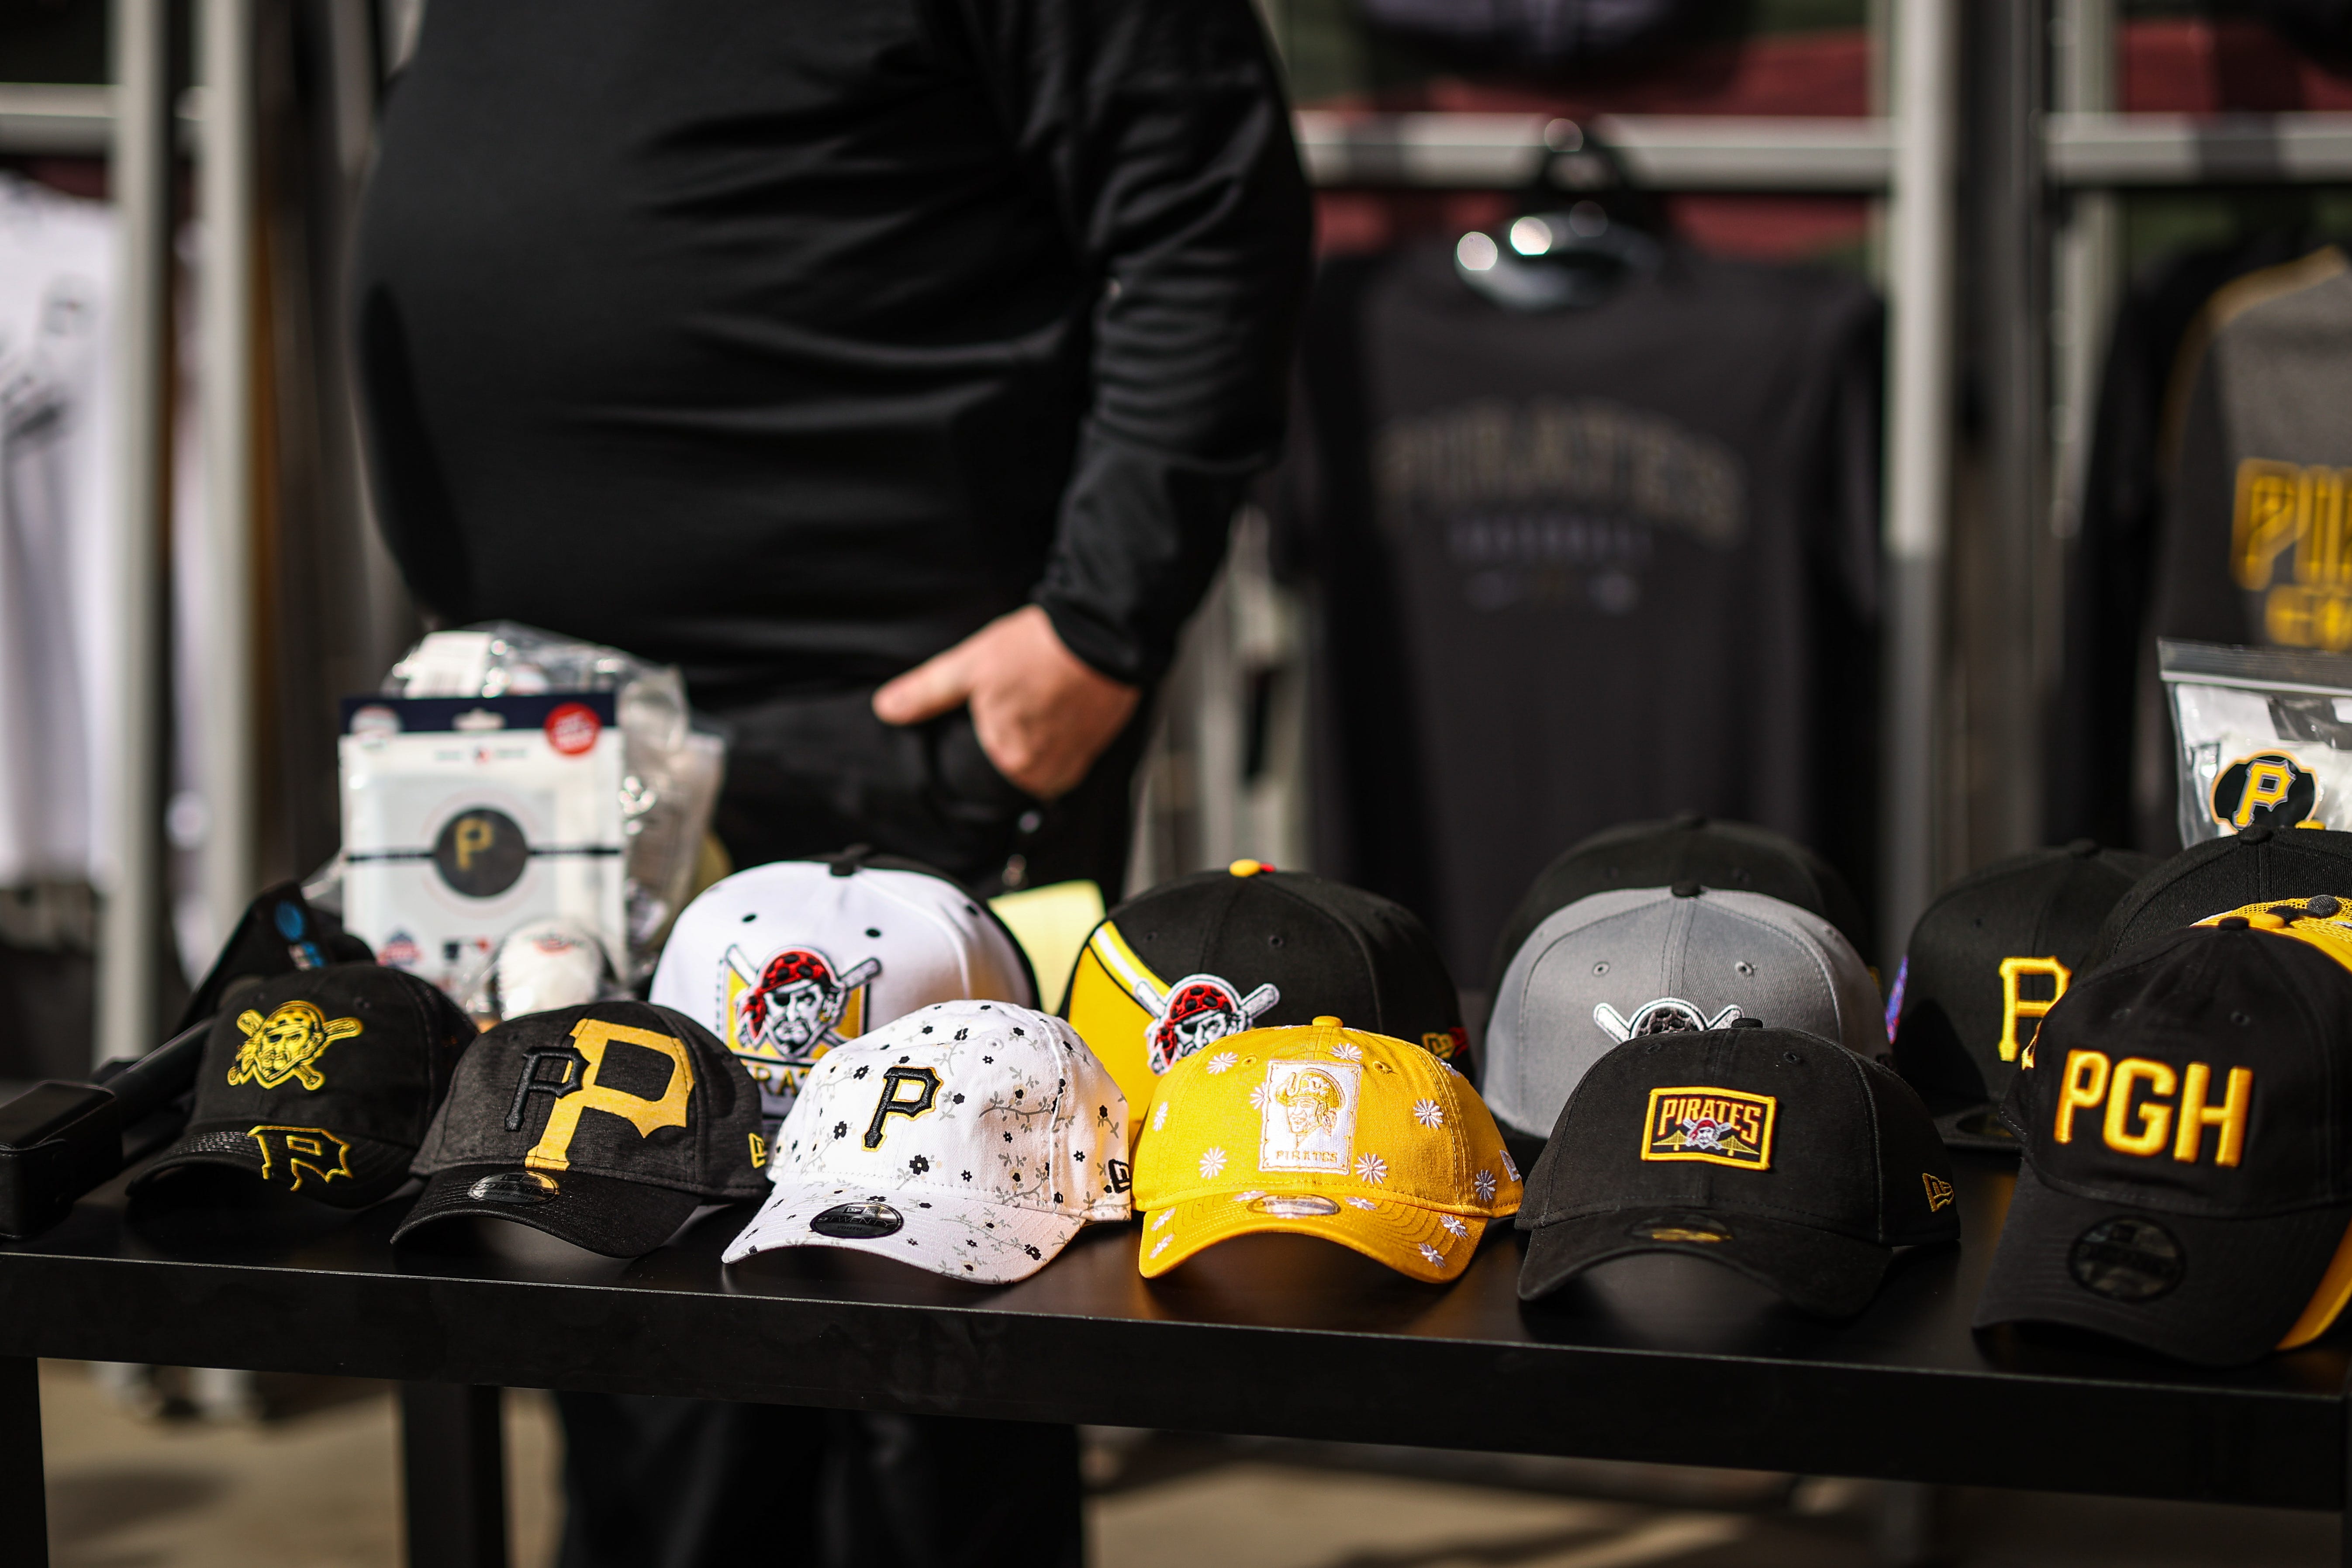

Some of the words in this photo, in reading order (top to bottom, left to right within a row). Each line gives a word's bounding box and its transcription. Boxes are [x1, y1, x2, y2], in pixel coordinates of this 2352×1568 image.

[2231, 458, 2352, 591] PI
[2232, 758, 2297, 829] P
[455, 816, 494, 871] P
[1998, 955, 2072, 1062] P
[504, 1047, 590, 1131] P
[525, 1018, 695, 1171] P
[861, 1065, 943, 1152] P
[1657, 1097, 1762, 1145] PIRATES
[2054, 1049, 2254, 1168] PGH
[1276, 1150, 1338, 1163] PIRATES
[817, 1216, 897, 1227] 9TWENTY
